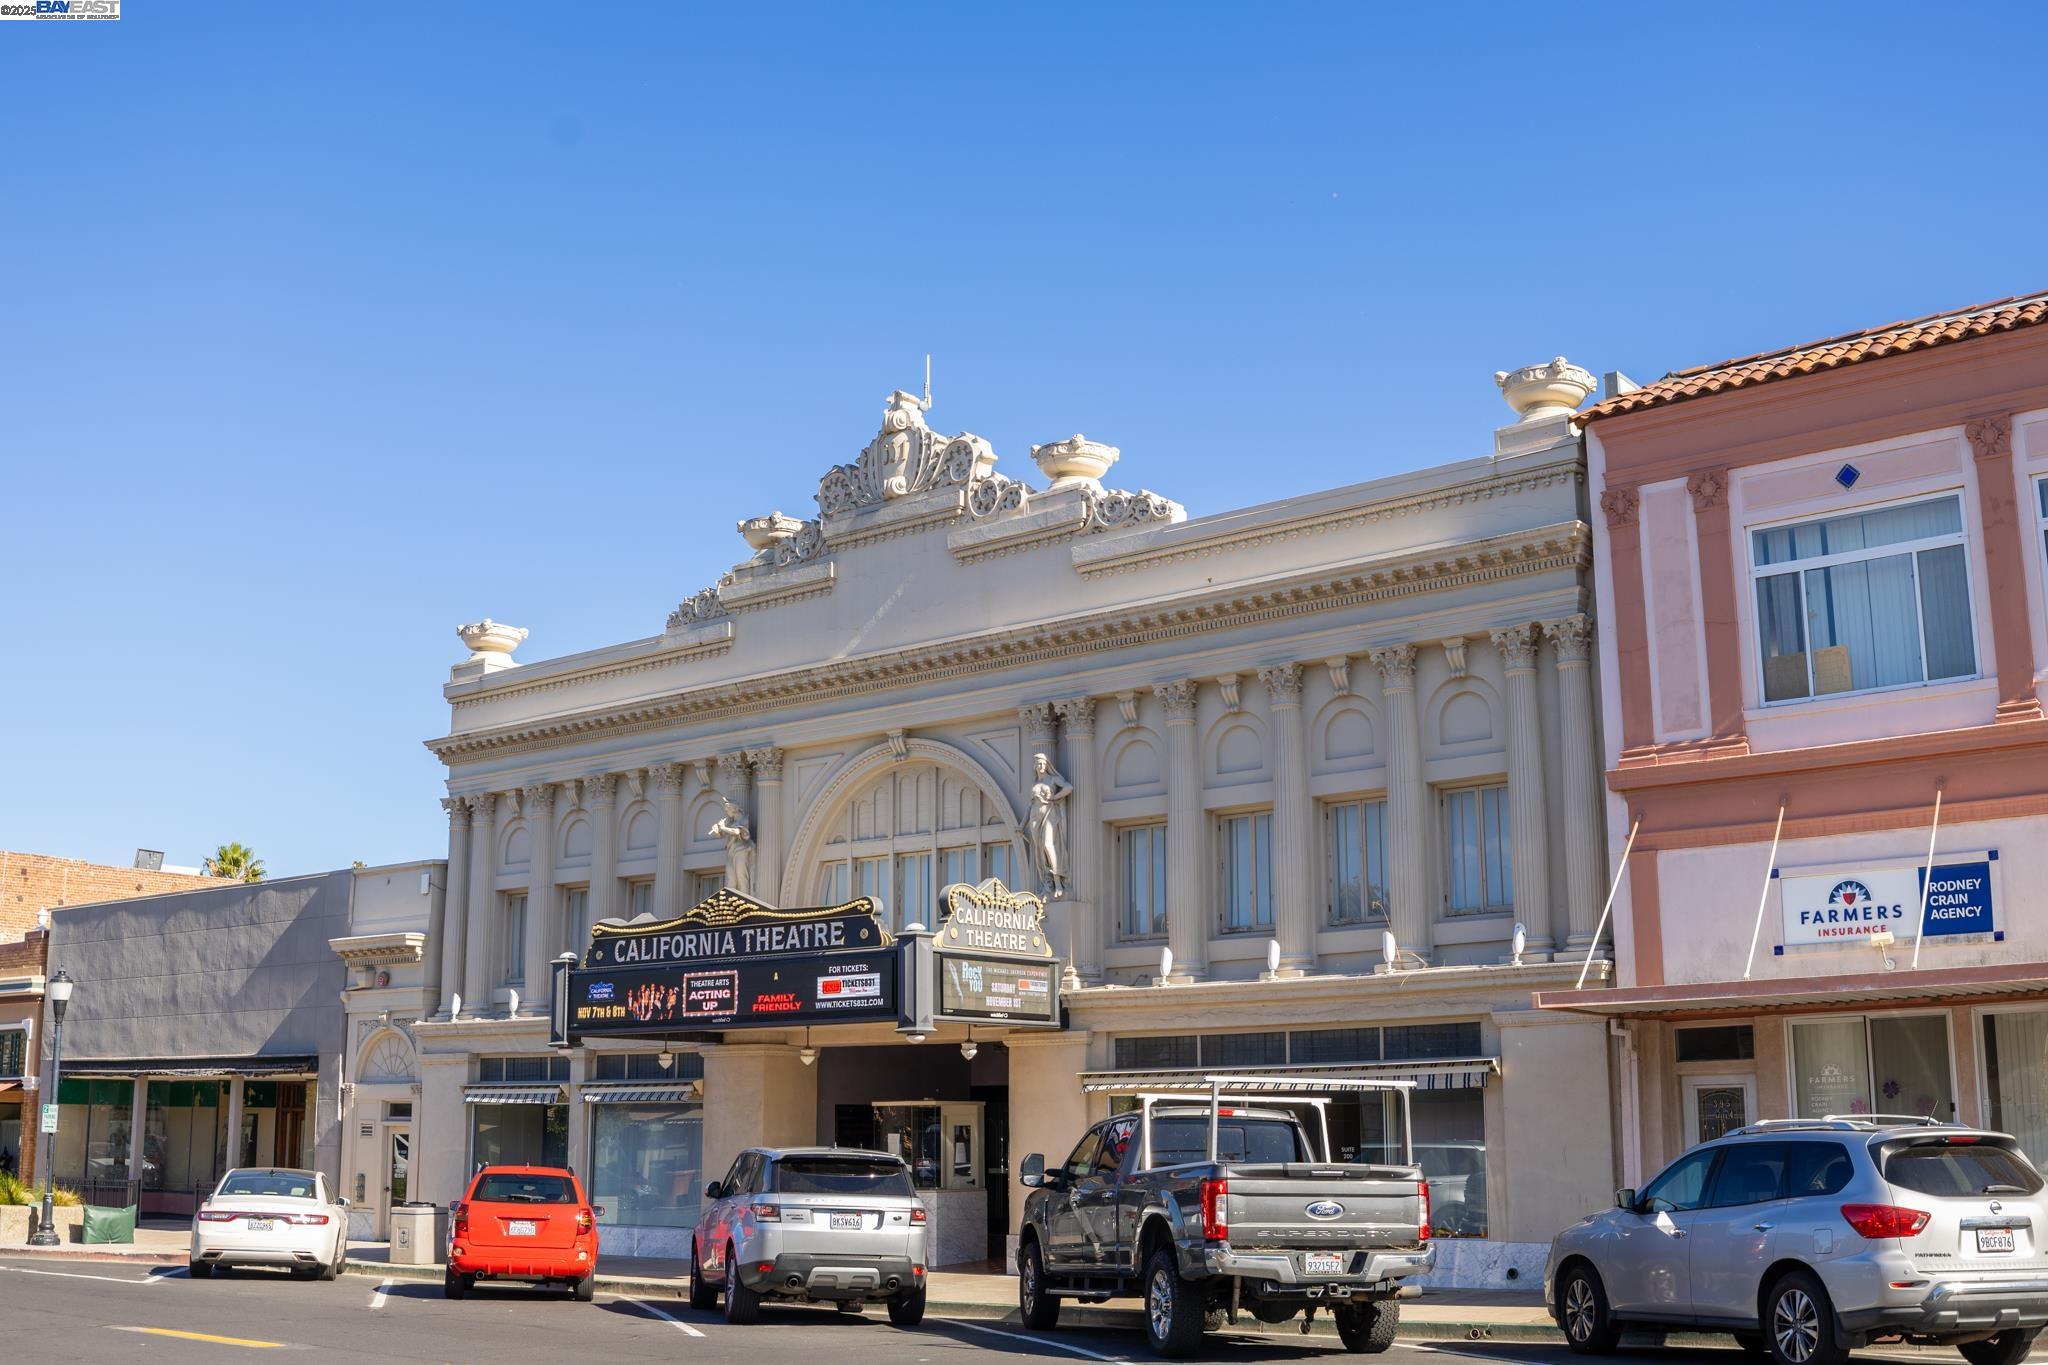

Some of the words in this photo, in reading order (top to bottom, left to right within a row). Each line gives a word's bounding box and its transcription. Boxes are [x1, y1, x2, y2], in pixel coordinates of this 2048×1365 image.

[1929, 878, 1982, 893] RODNEY
[1930, 893, 1968, 906] CRAIN
[956, 907, 1036, 931] CALIFORNIA
[1800, 904, 1903, 925] FARMERS
[1930, 905, 1982, 920] AGENCY
[1818, 924, 1887, 937] INSURANCE
[614, 930, 736, 963] CALIFORNIA
[742, 921, 845, 953] THEATRE
[966, 929, 1027, 951] THEATRE
[828, 965, 841, 974] FOR
[842, 964, 869, 973] TICKETS:
[690, 979, 715, 987] THEATRE
[715, 978, 730, 986] ARTS
[842, 978, 875, 988] TICKETS831
[969, 979, 983, 992] YOU
[689, 989, 731, 1000] ACTING
[757, 993, 796, 1003] FAMILY
[702, 1001, 718, 1011] UP
[752, 1001, 802, 1012] FRIENDLY
[815, 998, 884, 1009] WWW.TICKETS831.COM
[577, 1006, 591, 1019] NOV
[592, 1006, 605, 1018] 7TH
[612, 1005, 626, 1017] 8TH
[1809, 1074, 1856, 1084] FARMERS
[1315, 1203, 1336, 1216] Ford
[1980, 1236, 2012, 1248] 9BCF876
